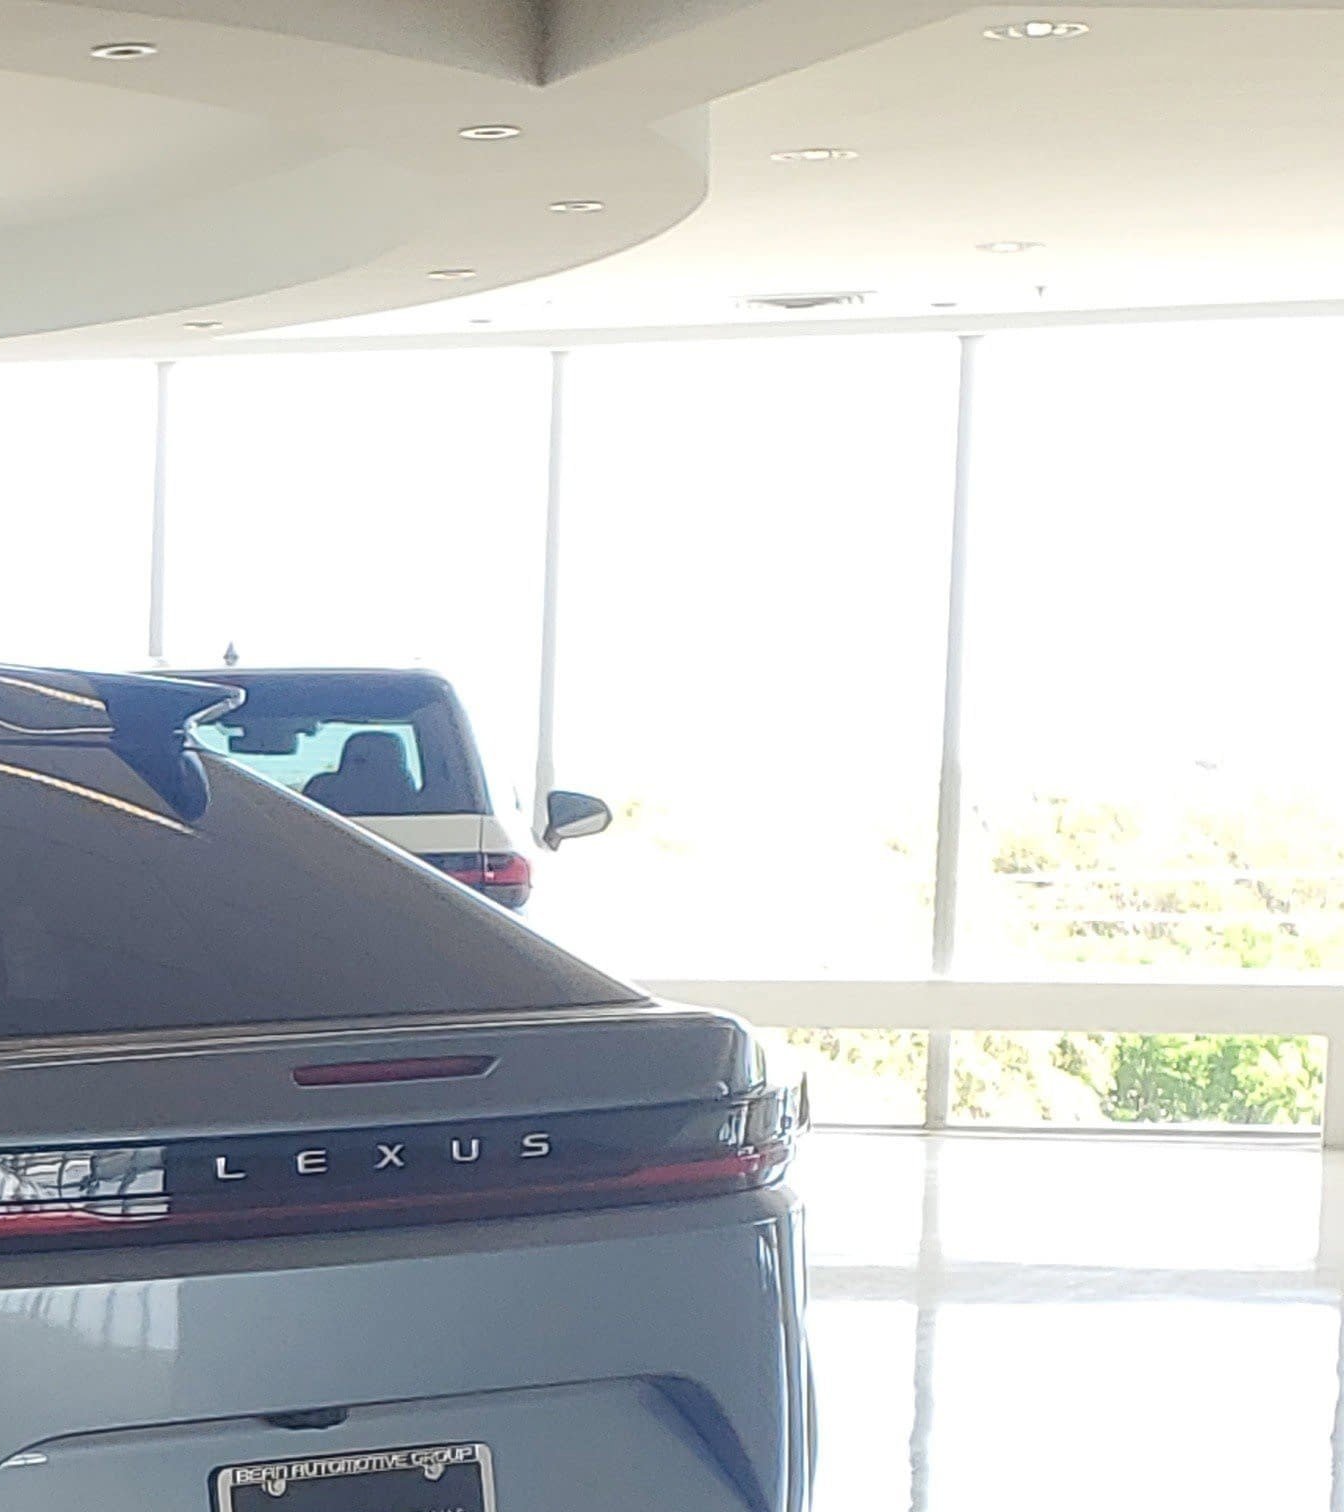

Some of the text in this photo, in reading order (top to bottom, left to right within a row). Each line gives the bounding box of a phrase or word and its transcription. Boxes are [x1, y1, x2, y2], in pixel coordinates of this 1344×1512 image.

[215, 1133, 550, 1181] LEXUS
[292, 1455, 409, 1478] AUTOMOTIVE
[411, 1447, 472, 1467] GROUP
